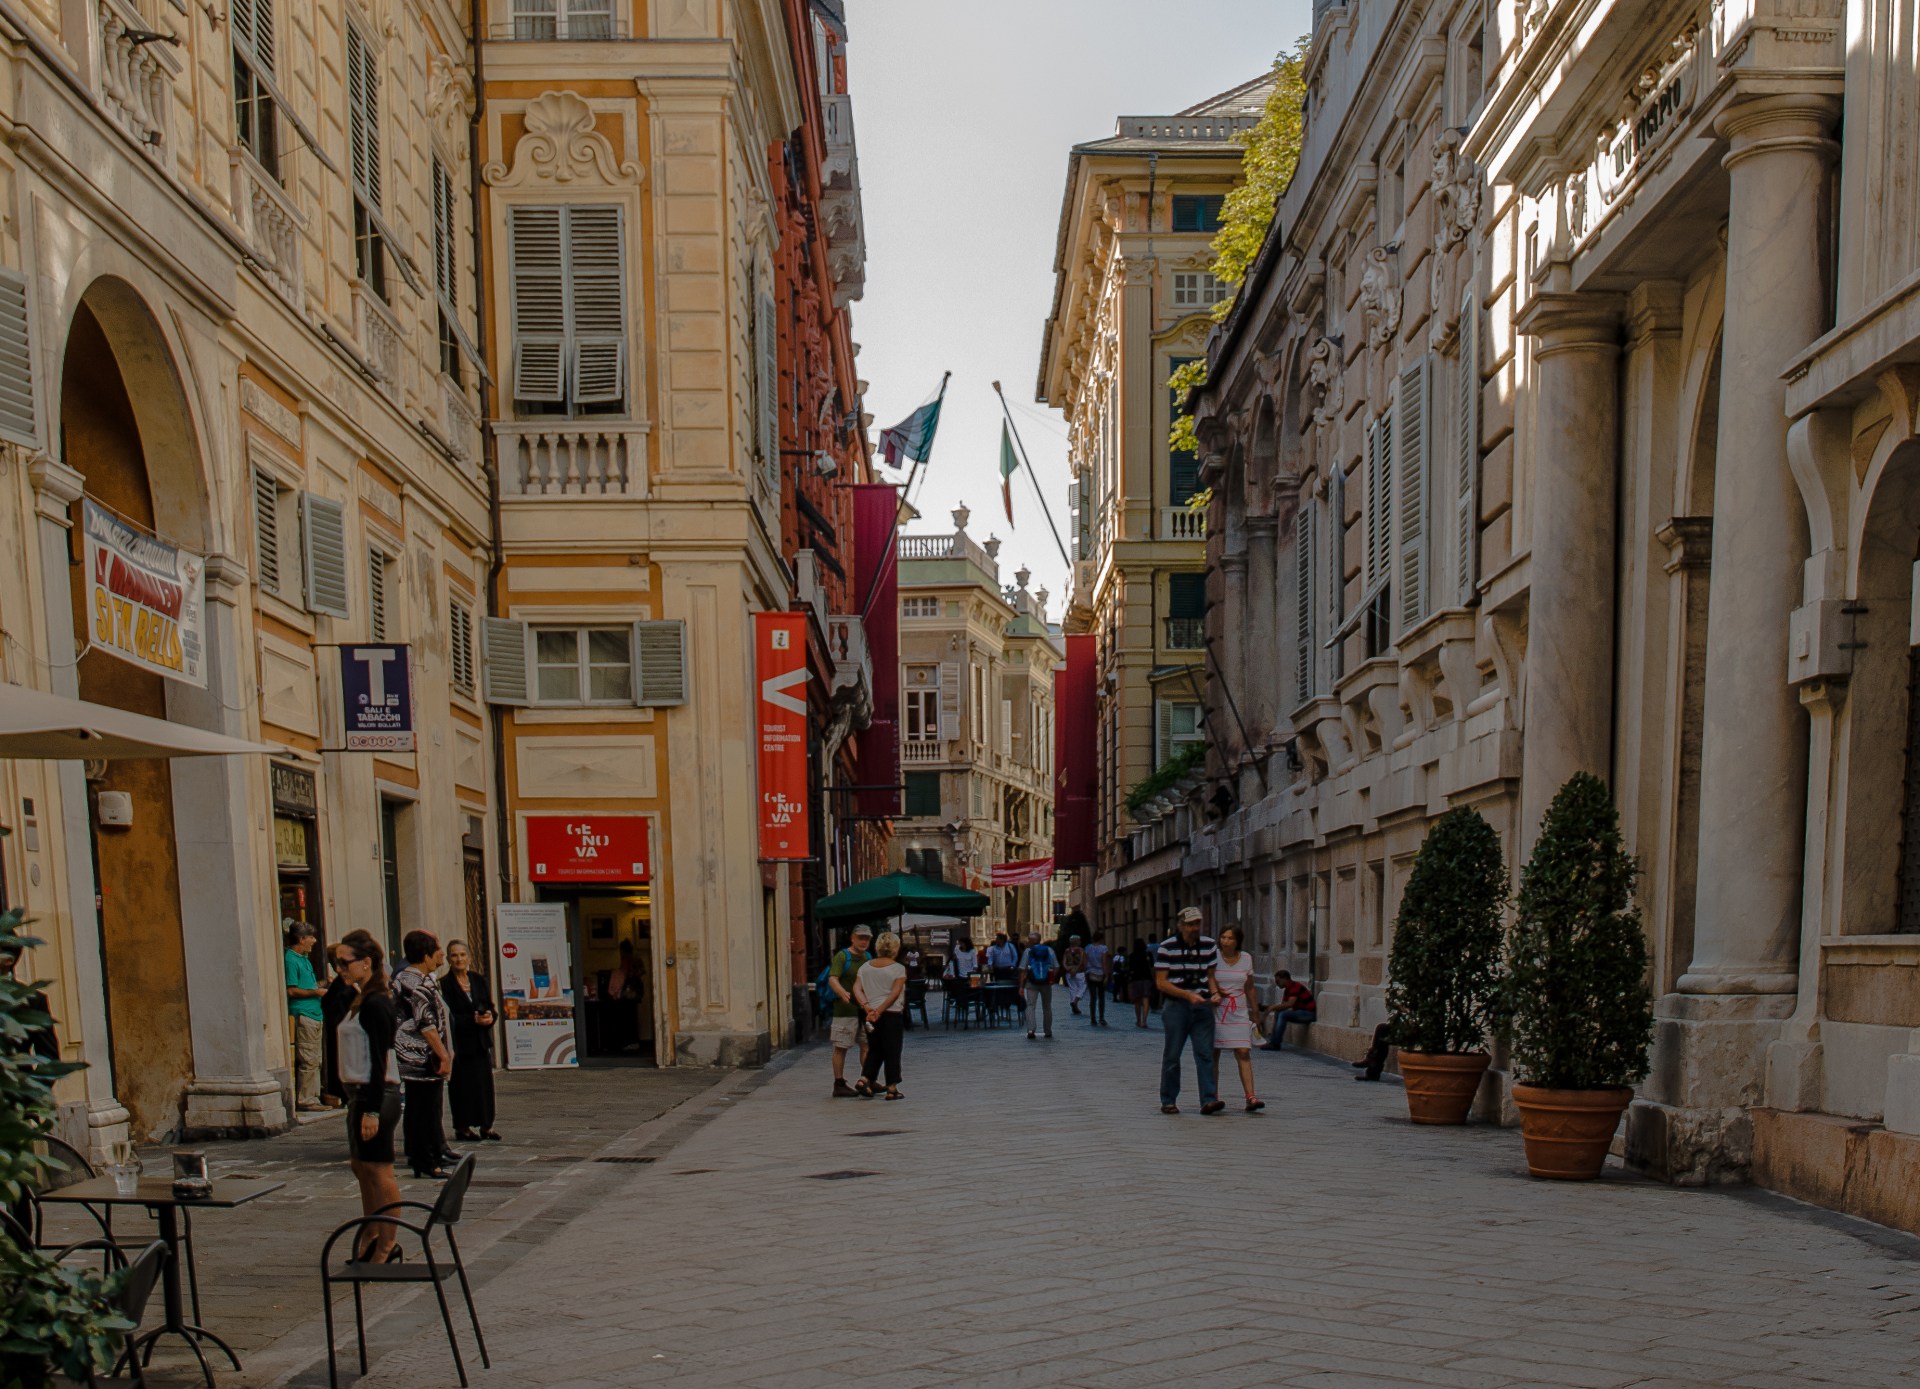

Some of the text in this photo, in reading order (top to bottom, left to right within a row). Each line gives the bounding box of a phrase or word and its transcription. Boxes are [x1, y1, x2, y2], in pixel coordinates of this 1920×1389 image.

[135, 607, 184, 672] BELLA
[353, 648, 396, 706] T
[364, 706, 391, 714] SALI E
[357, 713, 401, 722] TABACCHI
[763, 734, 801, 743] INFORMATION
[763, 744, 785, 752] CENTRE
